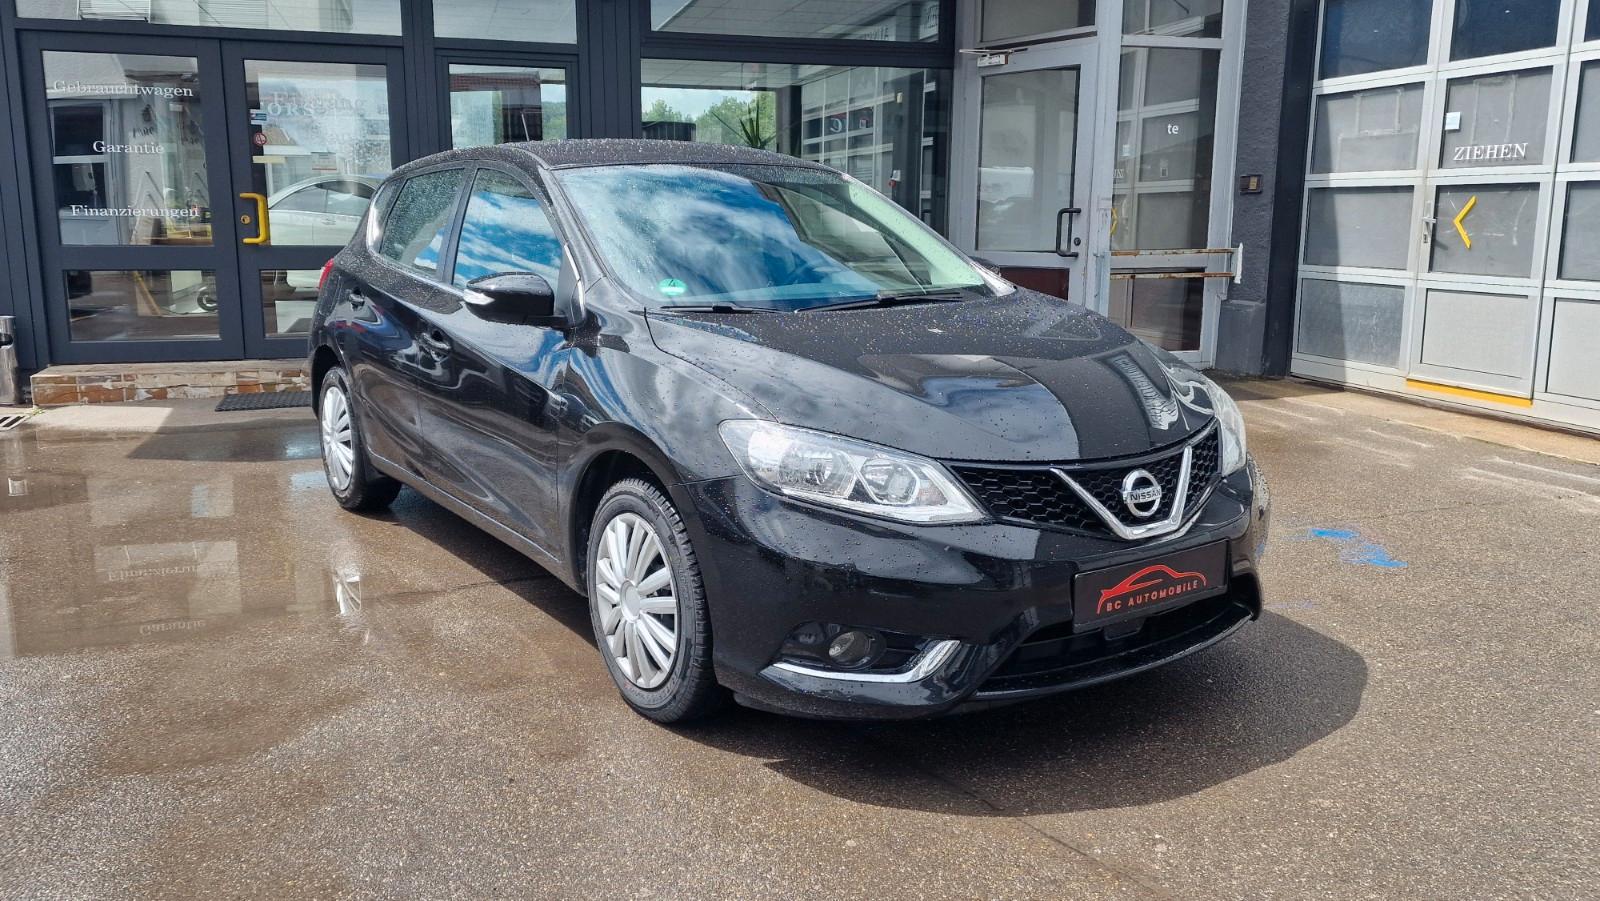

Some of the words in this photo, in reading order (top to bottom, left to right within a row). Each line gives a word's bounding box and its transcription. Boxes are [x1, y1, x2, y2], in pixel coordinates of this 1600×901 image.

[53, 80, 194, 98] Gebrauchtwagen
[1167, 123, 1180, 135] te
[92, 140, 164, 155] Garantie
[1453, 142, 1529, 161] ZIEHEN
[70, 204, 200, 217] Finanzierungen
[1130, 488, 1162, 501] NISSAN
[1106, 600, 1122, 613] BC
[1128, 579, 1199, 607] AUTOMOBILE
